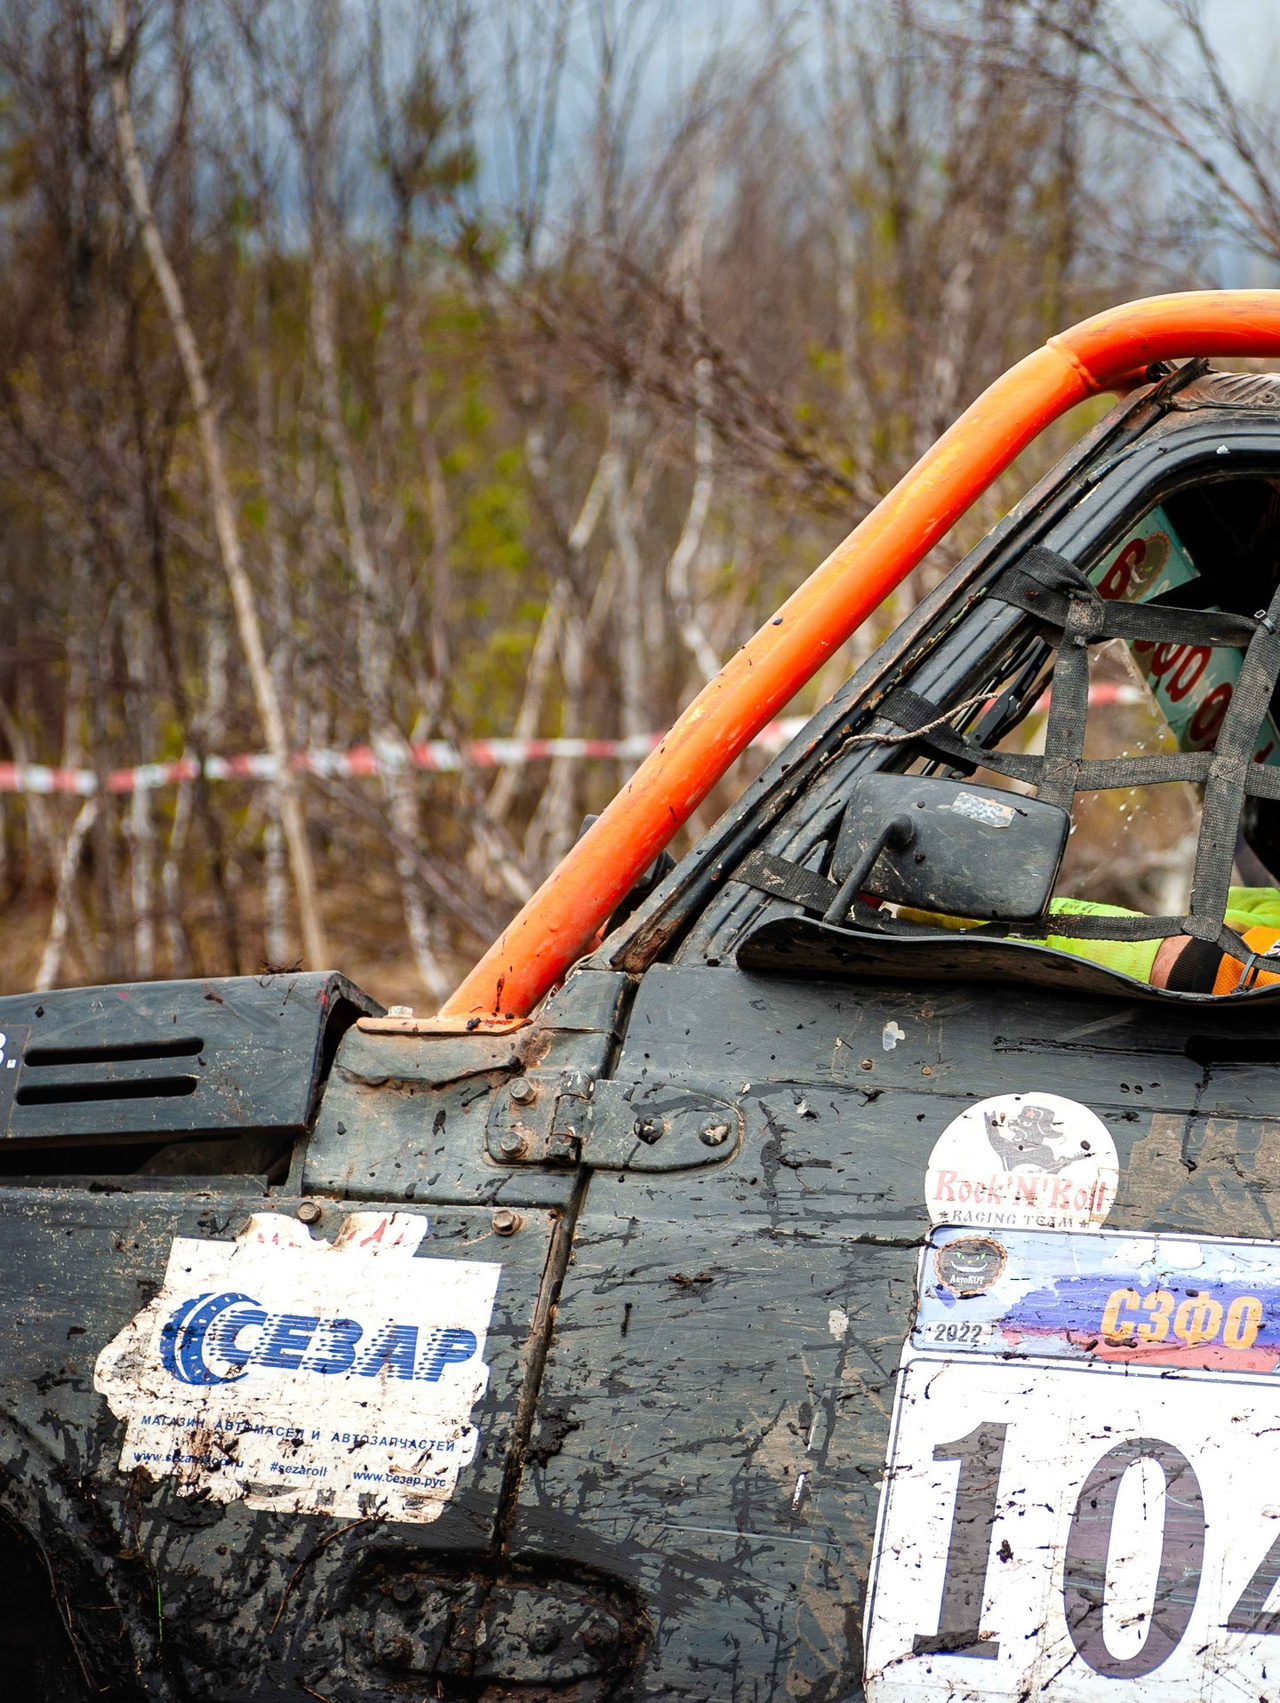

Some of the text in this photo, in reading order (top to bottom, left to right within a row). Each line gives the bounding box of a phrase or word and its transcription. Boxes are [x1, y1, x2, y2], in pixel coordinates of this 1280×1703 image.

[933, 1169, 1106, 1212] Rock'N'Roll
[952, 1209, 1073, 1229] RACING TEAM
[934, 1323, 983, 1343] 2022
[140, 1415, 206, 1429] МАГАЗИН
[311, 1430, 321, 1441] И
